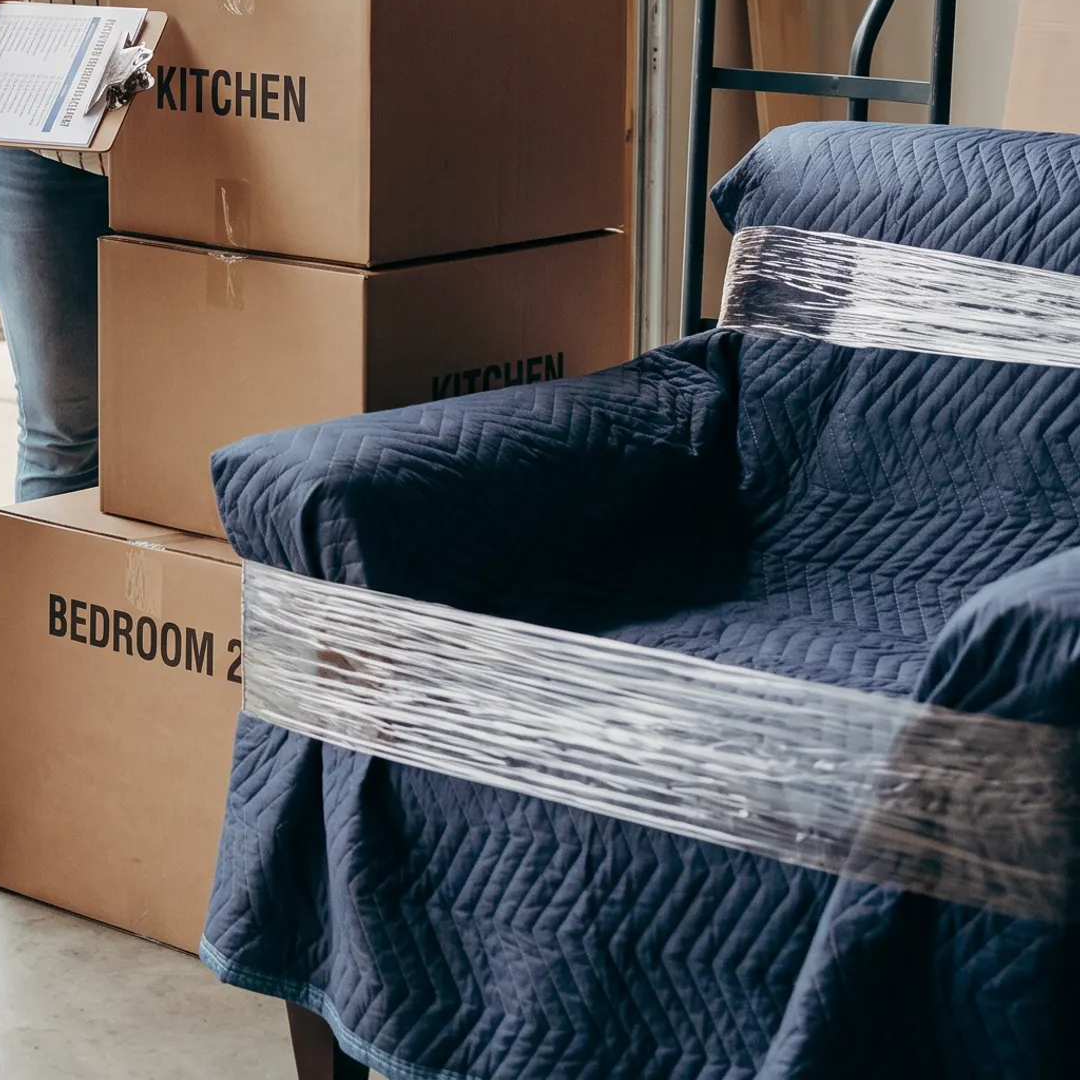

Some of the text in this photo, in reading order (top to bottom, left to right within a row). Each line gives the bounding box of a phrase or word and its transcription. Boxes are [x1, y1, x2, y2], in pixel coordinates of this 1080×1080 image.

[157, 65, 306, 123] KITCHEN
[49, 593, 242, 684] BEDROOM 2
